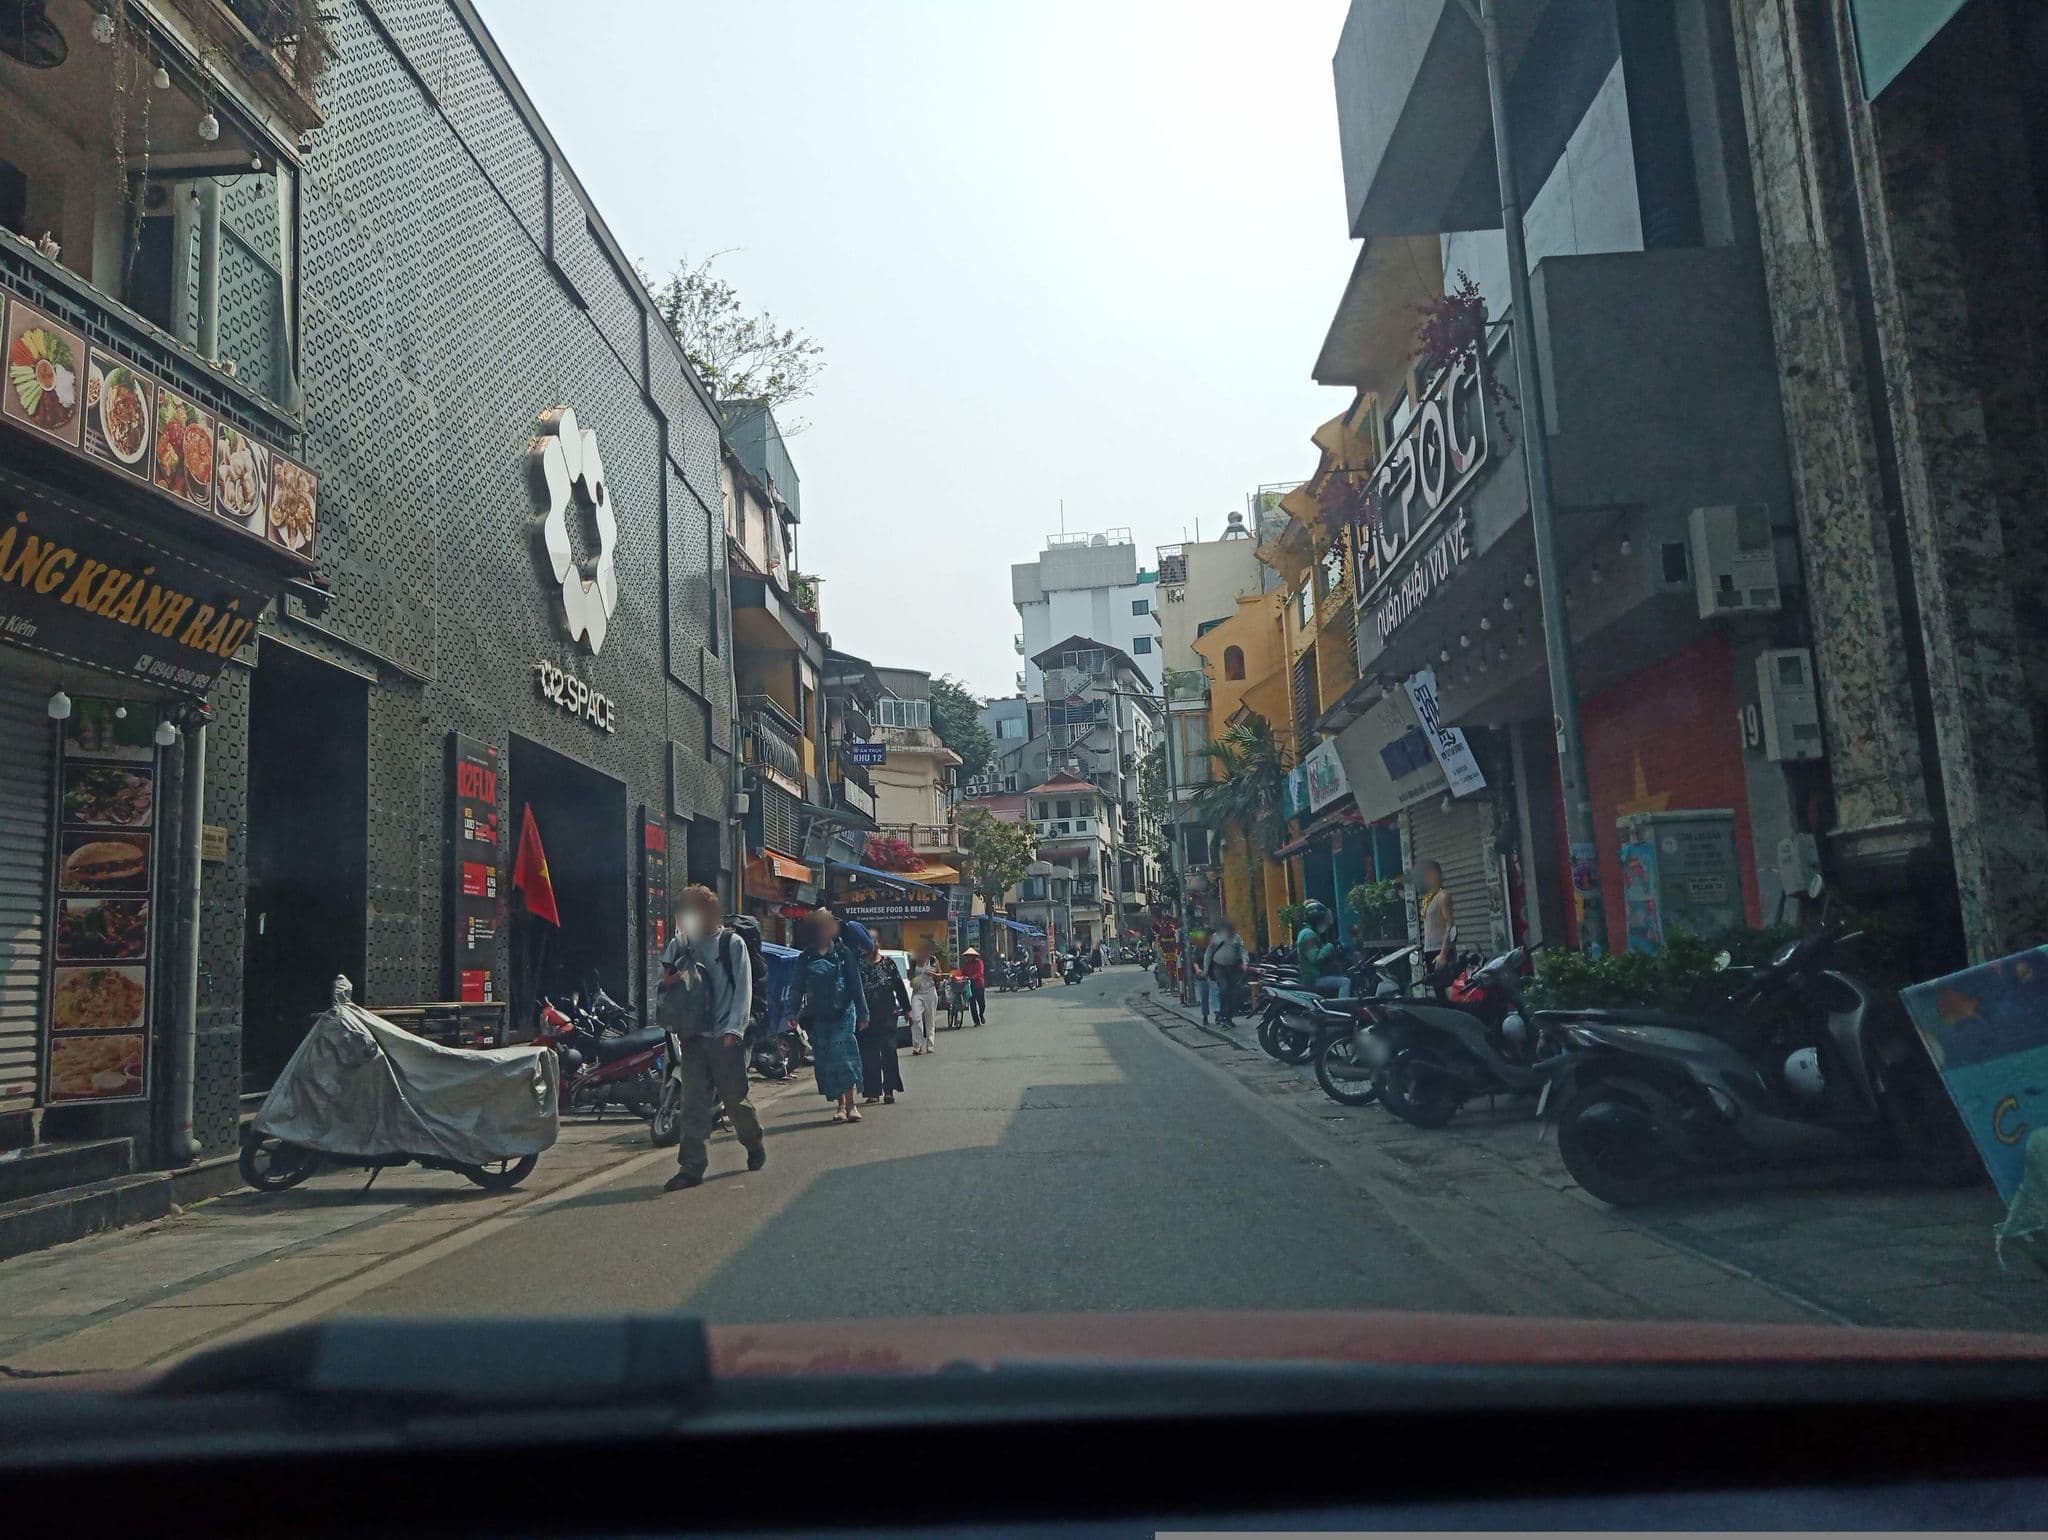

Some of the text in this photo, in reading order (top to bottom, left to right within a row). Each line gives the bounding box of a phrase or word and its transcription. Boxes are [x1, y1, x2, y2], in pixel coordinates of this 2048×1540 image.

[61, 559, 194, 637] KHÁNH
[180, 600, 253, 657] RÂU
[565, 674, 615, 734] SPACE
[1737, 704, 1759, 749] 19
[853, 754, 883, 762] KHU 12
[845, 906, 885, 914] VIETNAMESE
[886, 906, 904, 914] FOOD
[910, 905, 931, 913] BREAD
